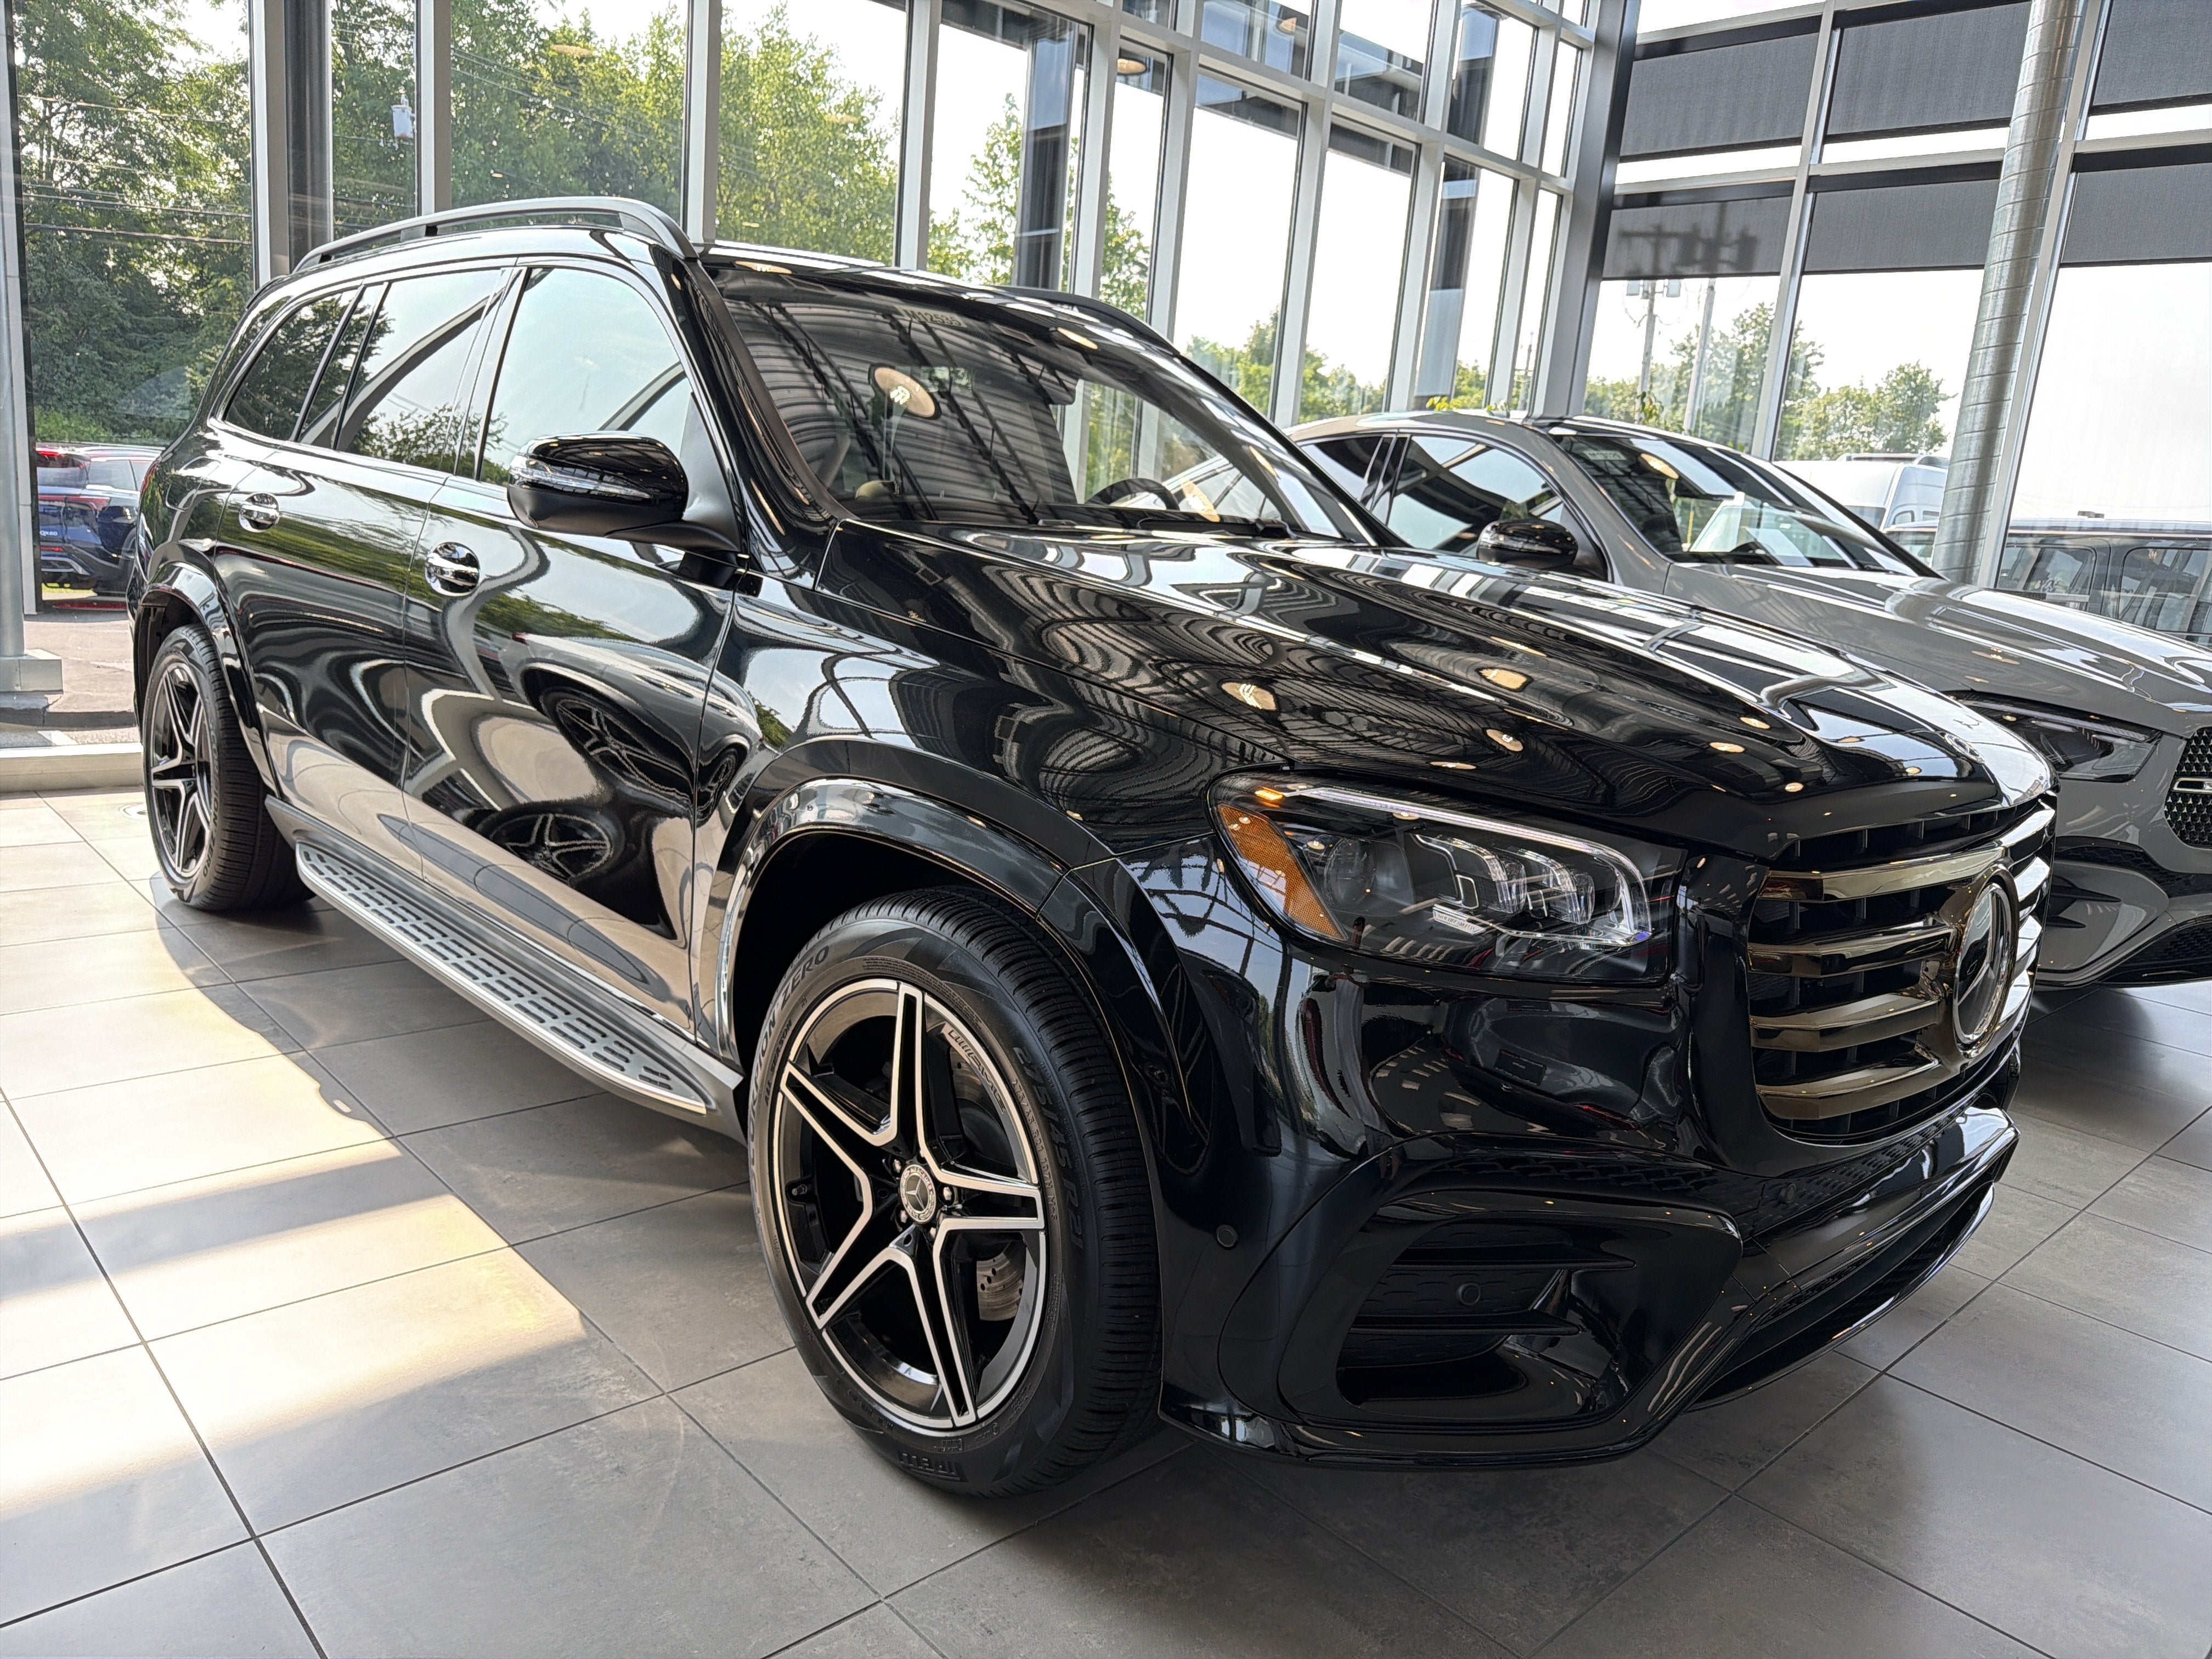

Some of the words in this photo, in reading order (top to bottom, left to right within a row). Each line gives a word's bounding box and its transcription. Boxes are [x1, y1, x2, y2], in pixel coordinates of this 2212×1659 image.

[902, 309, 962, 326] M12535
[203, 831, 216, 877] ZERO
[781, 945, 830, 1009] ZERO
[771, 1018, 792, 1071] SEASON
[1013, 1047, 1072, 1169] 275/45
[1063, 1177, 1084, 1249] R21
[1032, 1129, 1044, 1152] R21
[1041, 1158, 1053, 1189] 107H
